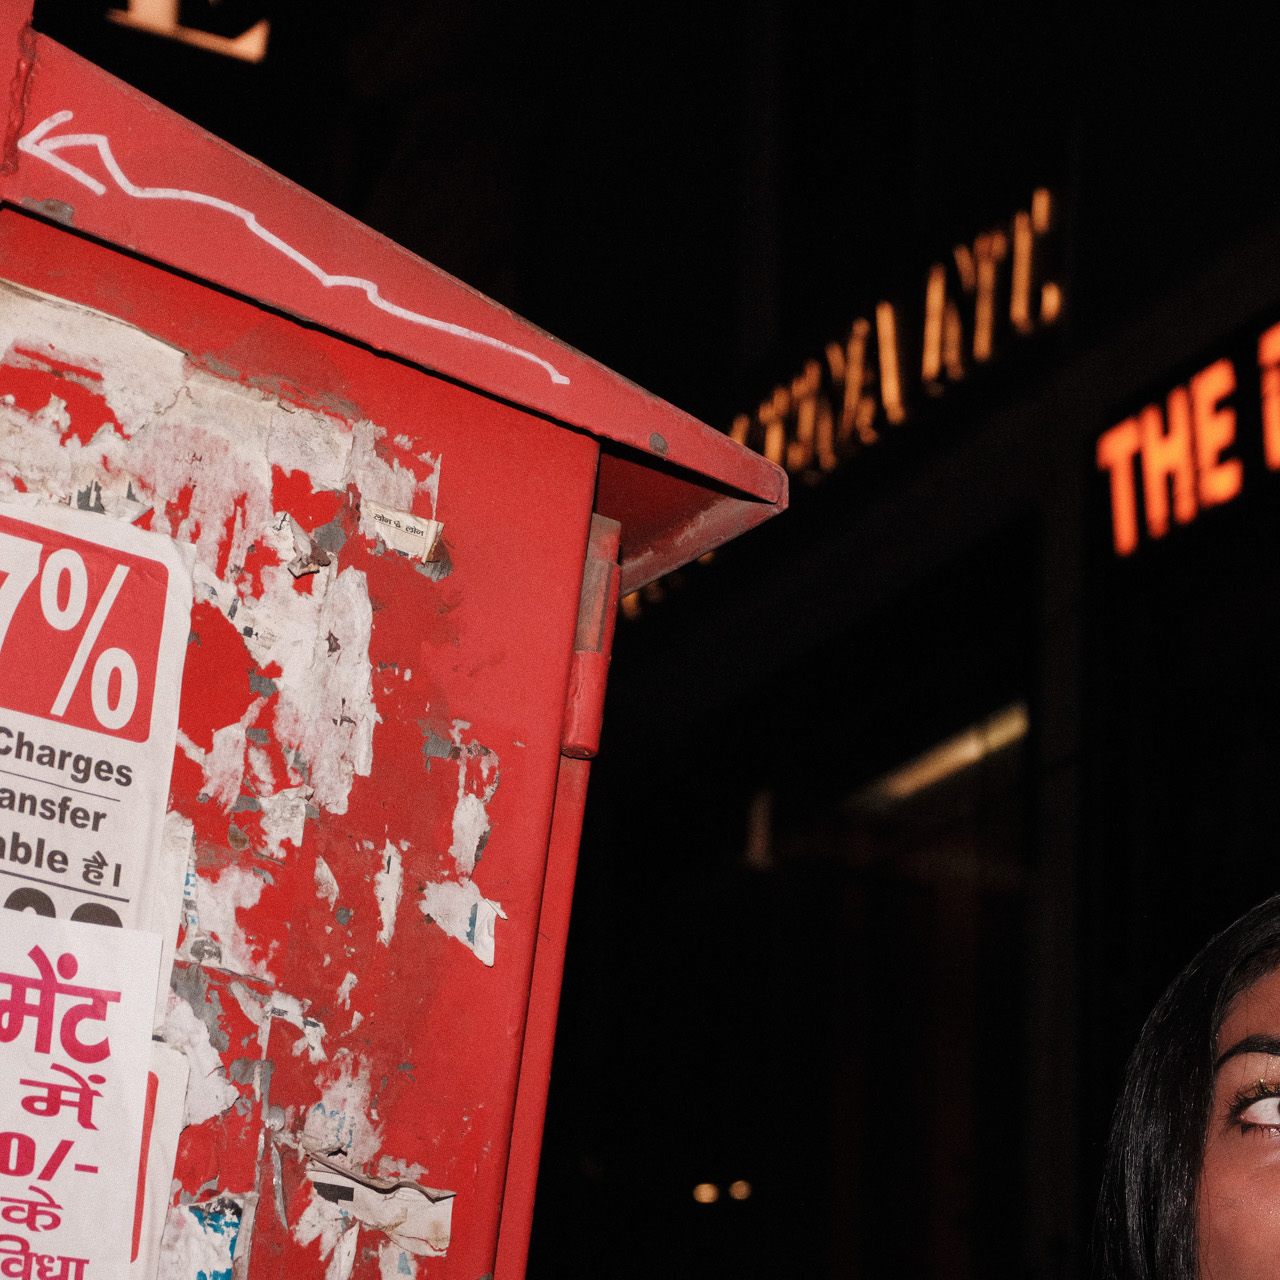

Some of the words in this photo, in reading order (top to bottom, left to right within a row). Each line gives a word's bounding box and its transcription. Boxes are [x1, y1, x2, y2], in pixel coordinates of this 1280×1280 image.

[1097, 358, 1243, 557] THE
[20, 1062, 106, 1131] में
[0, 1185, 64, 1233] के
